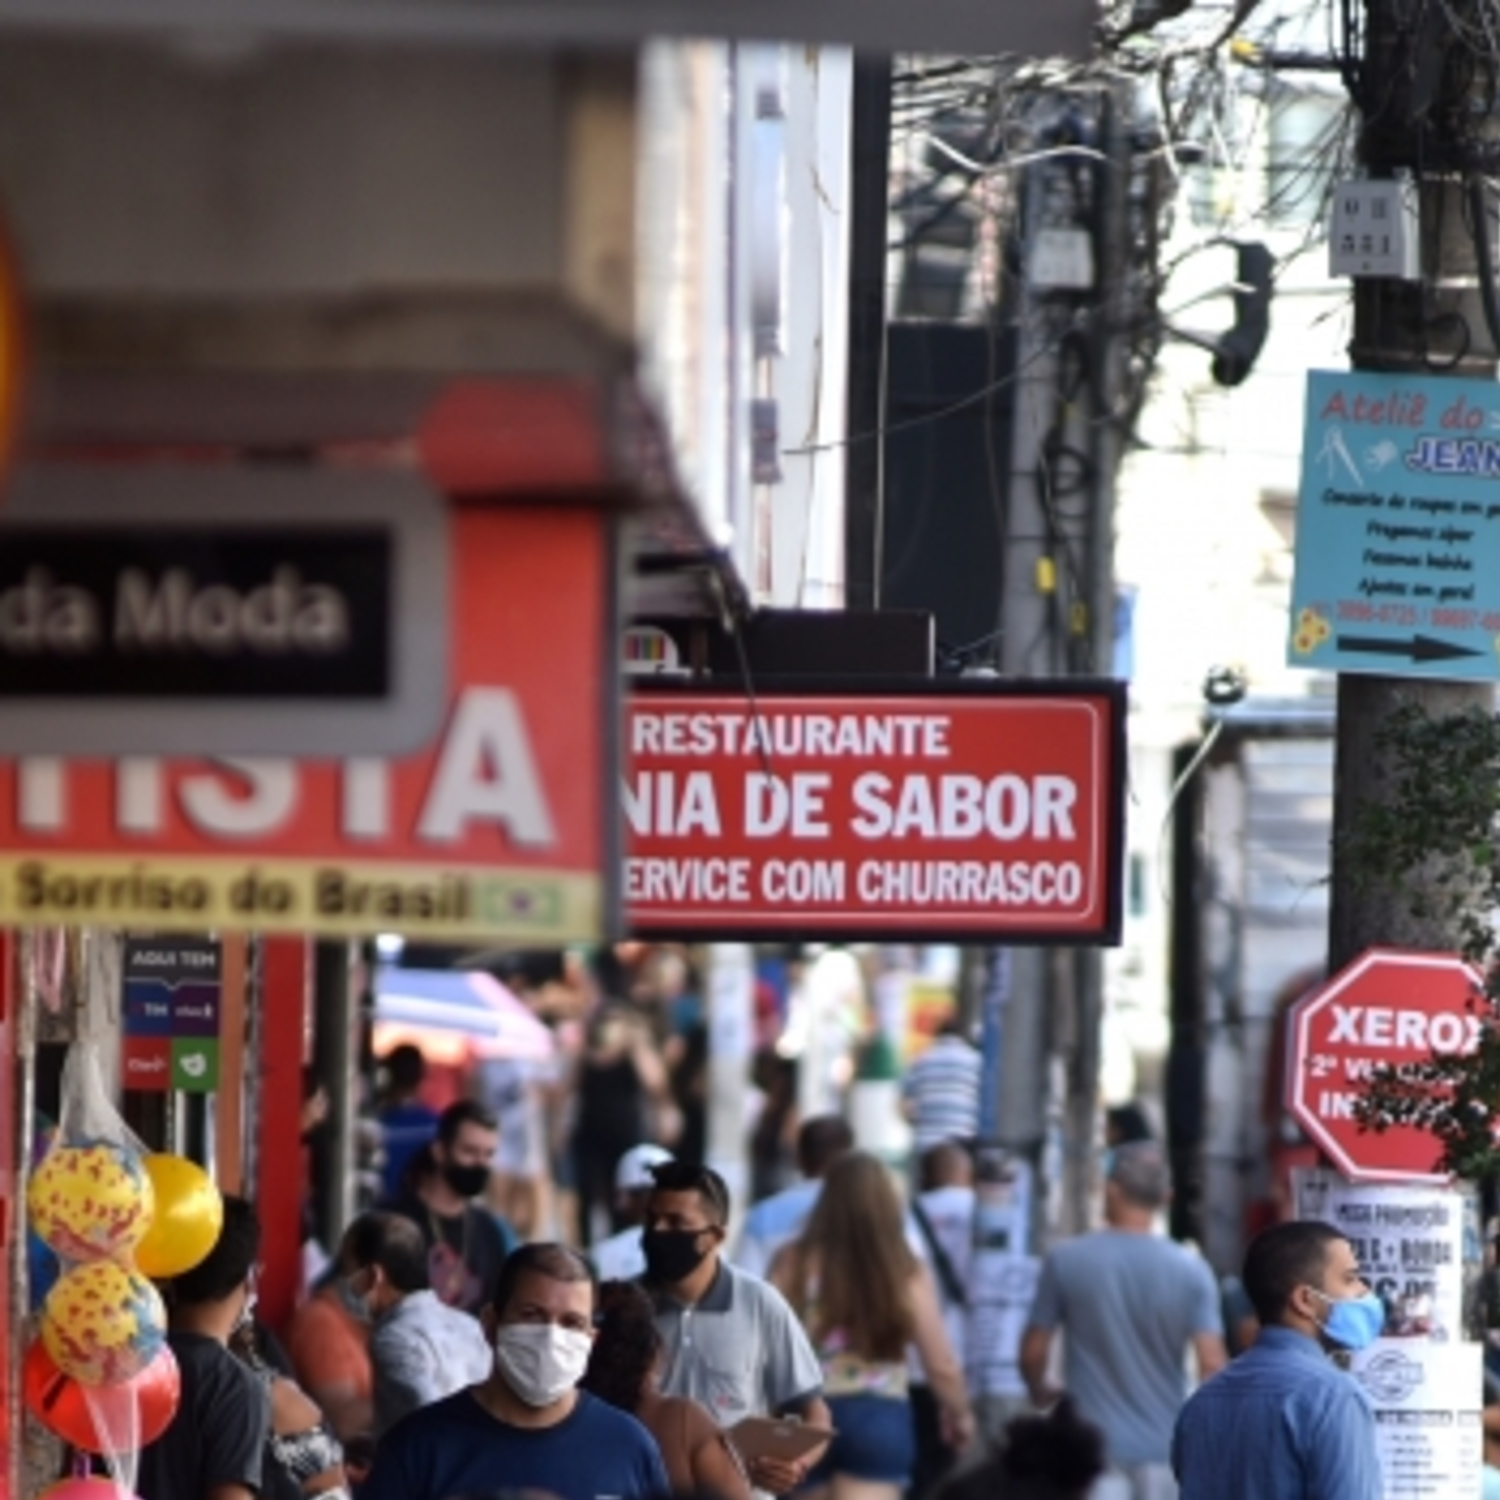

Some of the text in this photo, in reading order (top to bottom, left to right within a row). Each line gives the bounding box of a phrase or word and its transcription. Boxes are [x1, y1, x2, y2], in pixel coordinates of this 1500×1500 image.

[113, 562, 347, 654] Moda
[632, 713, 951, 757] RESTAURANTE
[744, 774, 831, 838] DE
[851, 773, 1078, 841] SABOR
[15, 861, 473, 922] Sorriso do Brasil
[761, 859, 845, 903] COM
[856, 860, 1082, 906] CHURRASCO
[132, 951, 216, 968] AQUI TEM
[144, 1002, 168, 1017] TIM
[1327, 1004, 1483, 1054] XEROX
